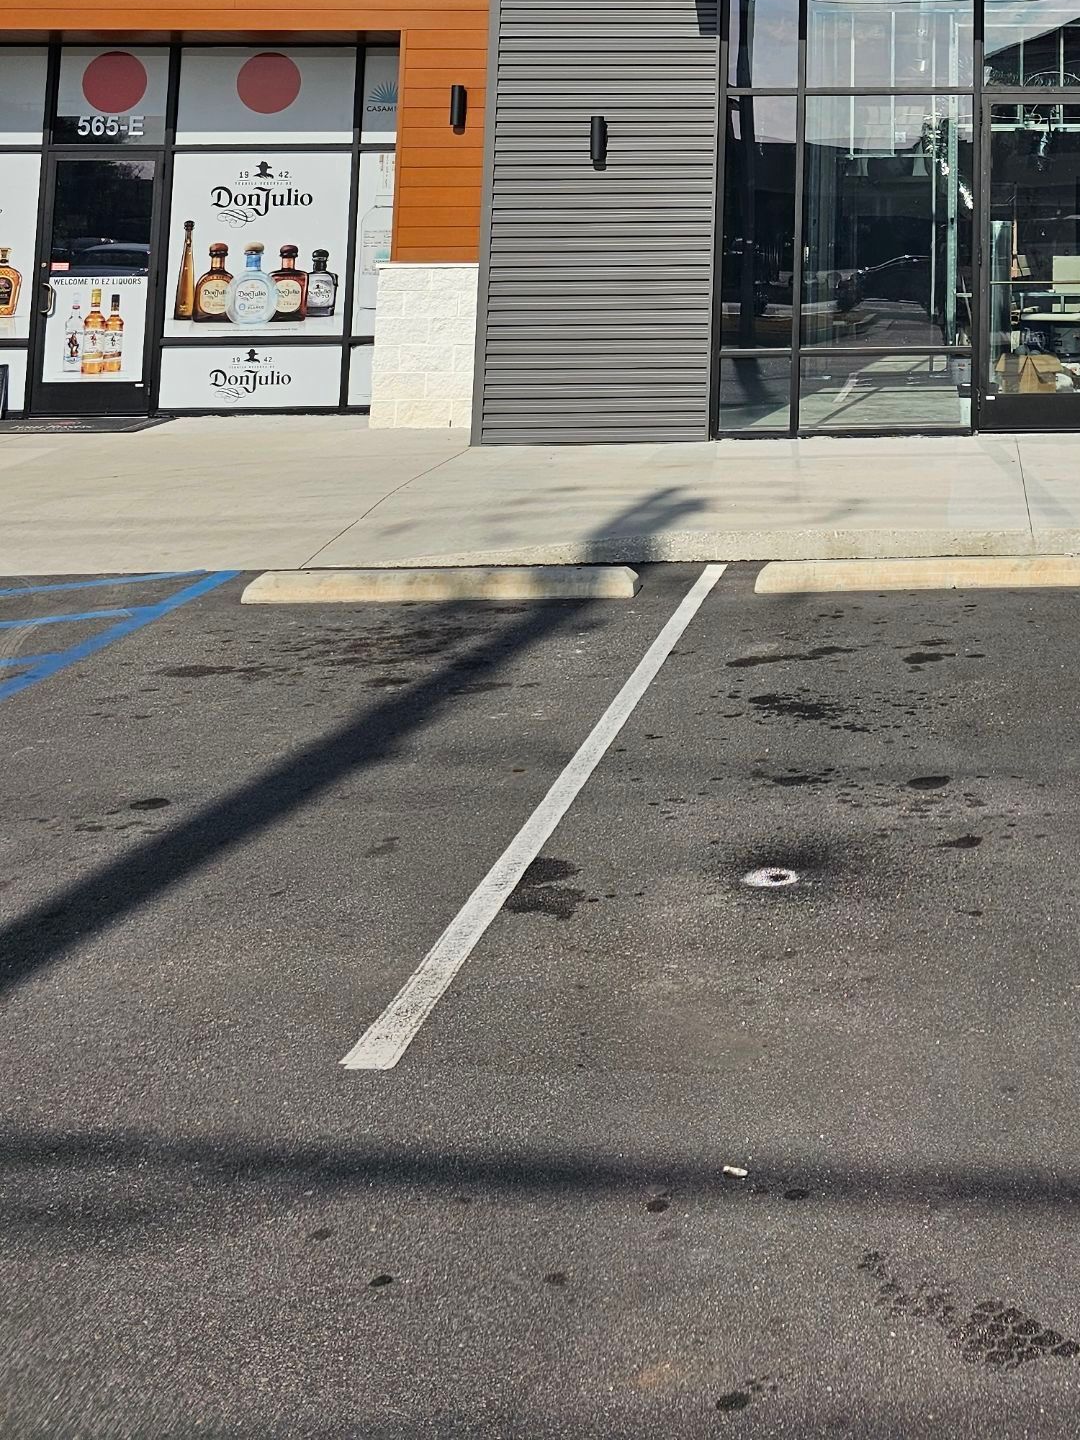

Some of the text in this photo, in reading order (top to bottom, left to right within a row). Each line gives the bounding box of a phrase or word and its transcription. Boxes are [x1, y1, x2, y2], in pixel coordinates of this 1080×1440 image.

[77, 116, 146, 136] 565-E
[239, 171, 249, 179] 19
[53, 278, 88, 286] WELCOME
[91, 278, 100, 286] TO
[112, 277, 142, 285] LIQUORS
